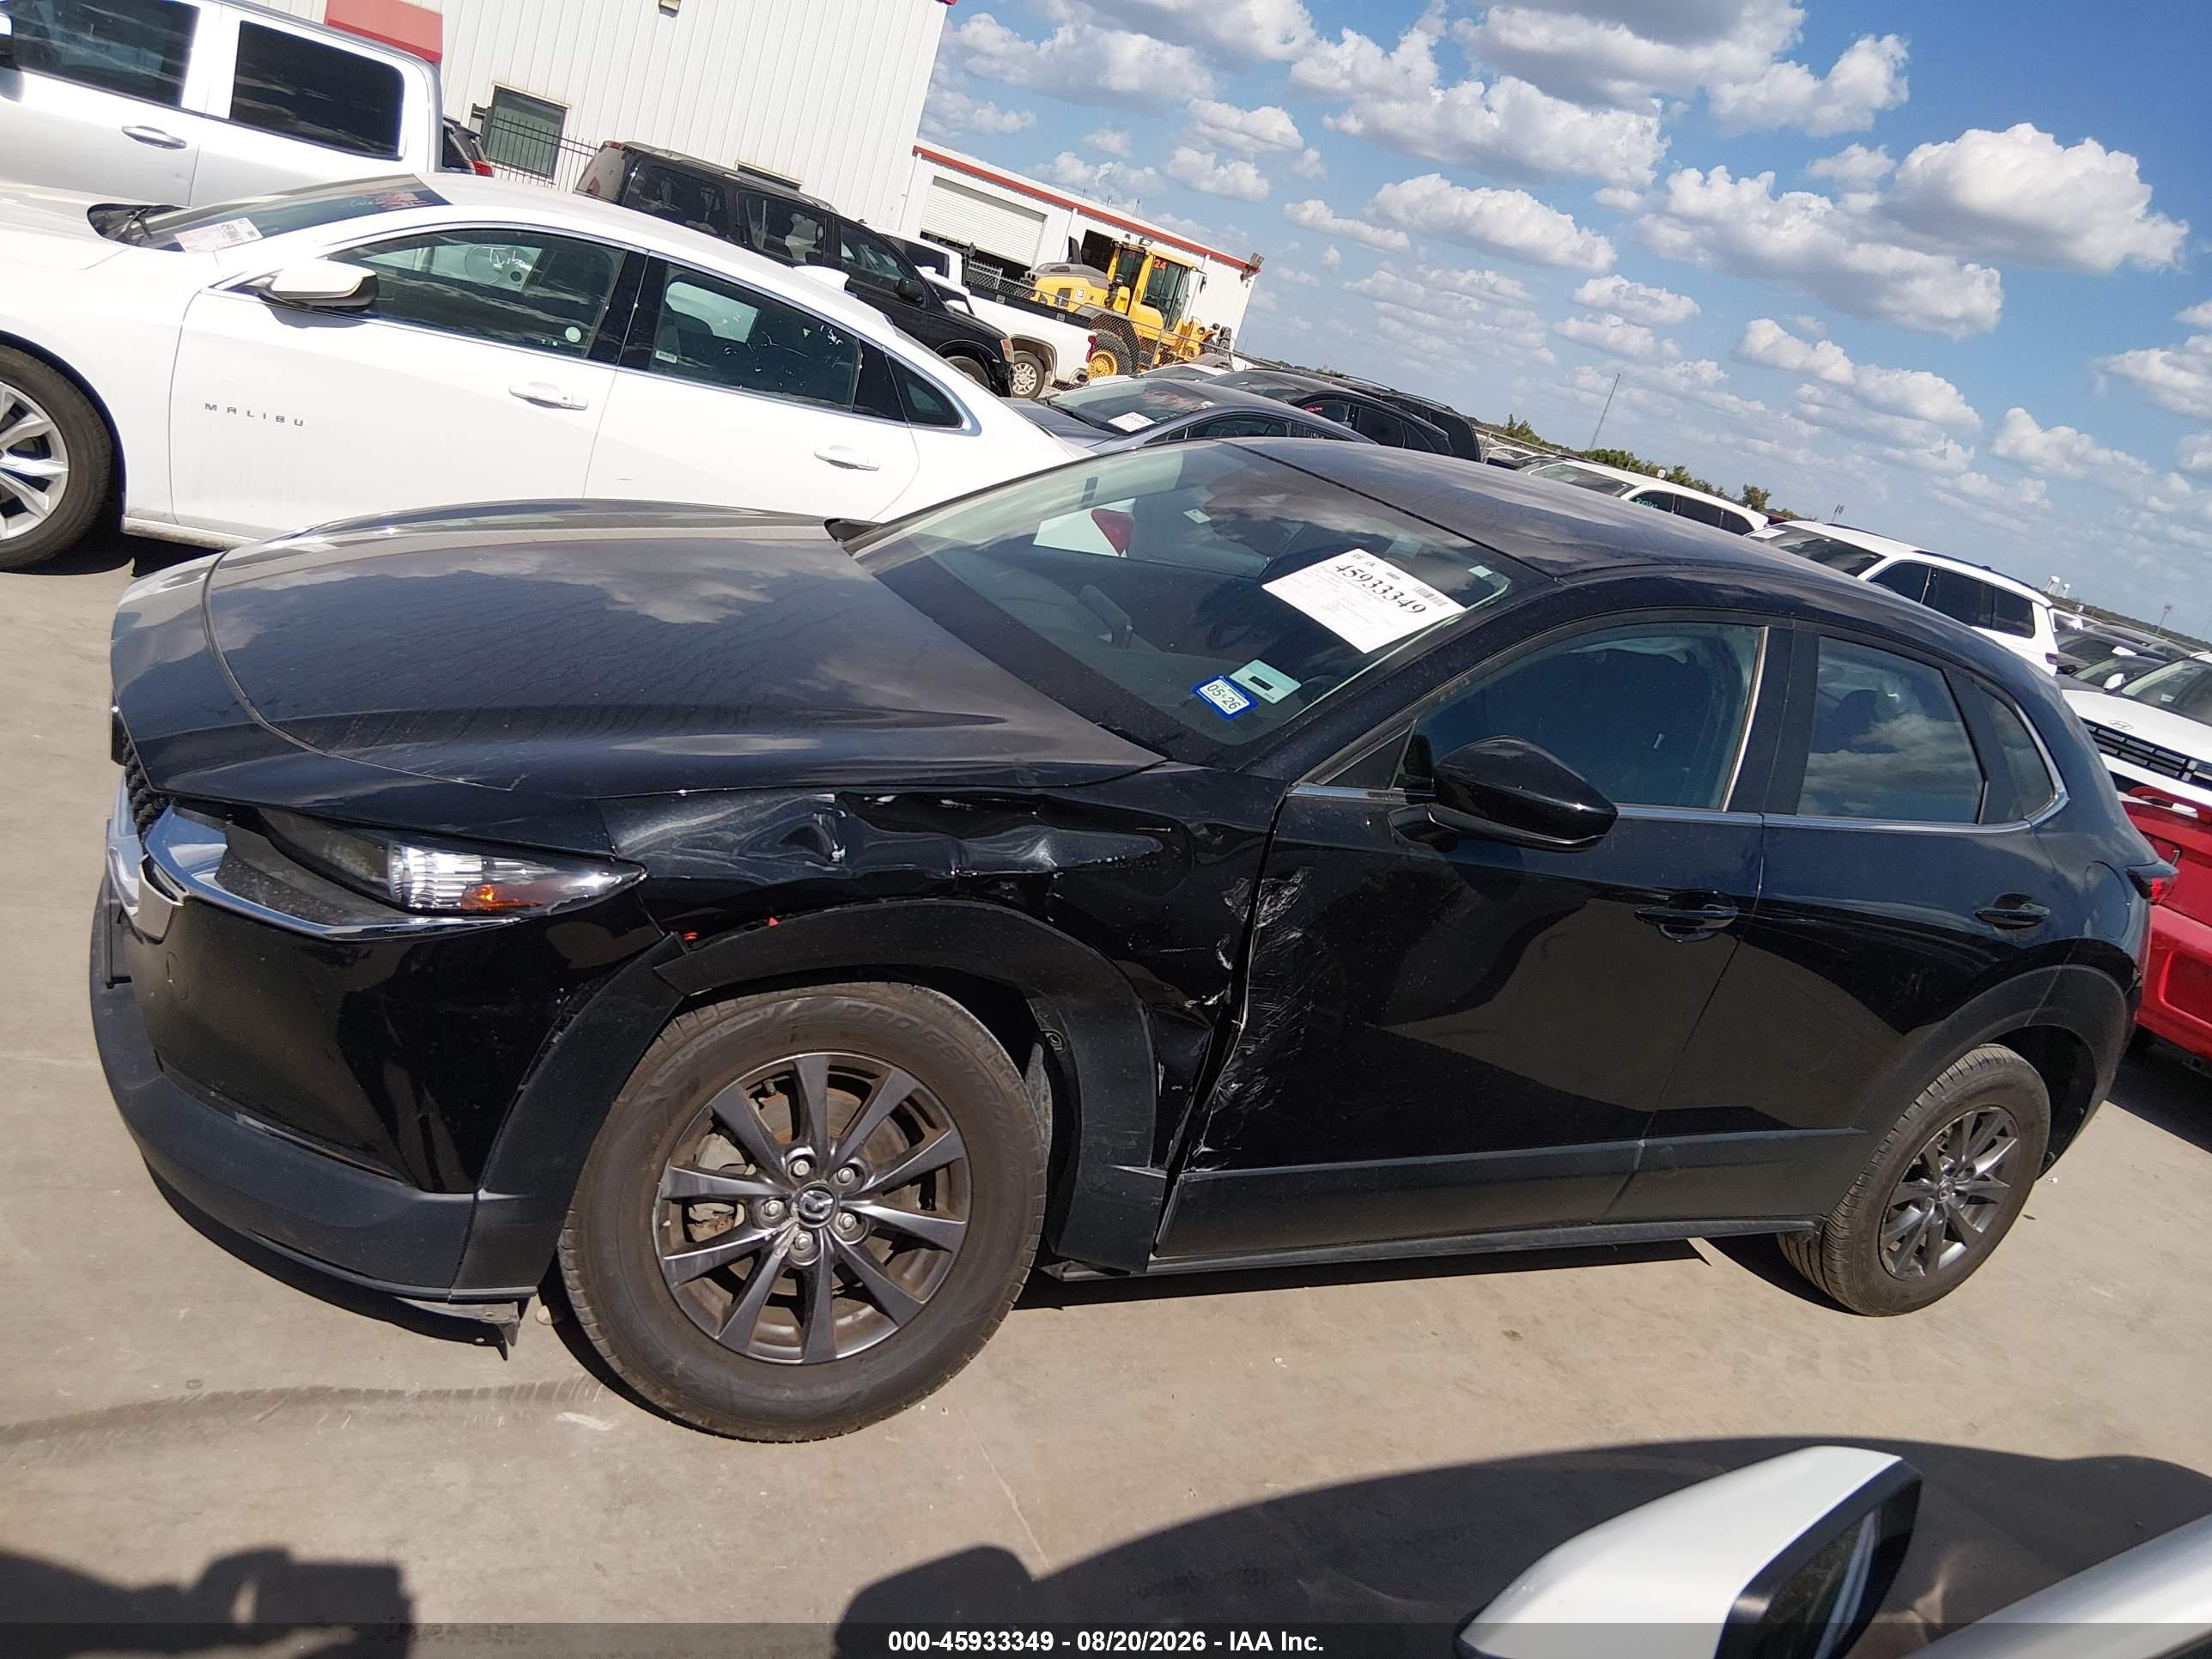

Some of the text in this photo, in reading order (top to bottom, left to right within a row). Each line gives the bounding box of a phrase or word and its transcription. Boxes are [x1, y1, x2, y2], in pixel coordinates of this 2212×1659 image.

[1153, 259, 1167, 270] 24
[204, 402, 304, 427] MALIBU
[1334, 565, 1426, 612] 45933349
